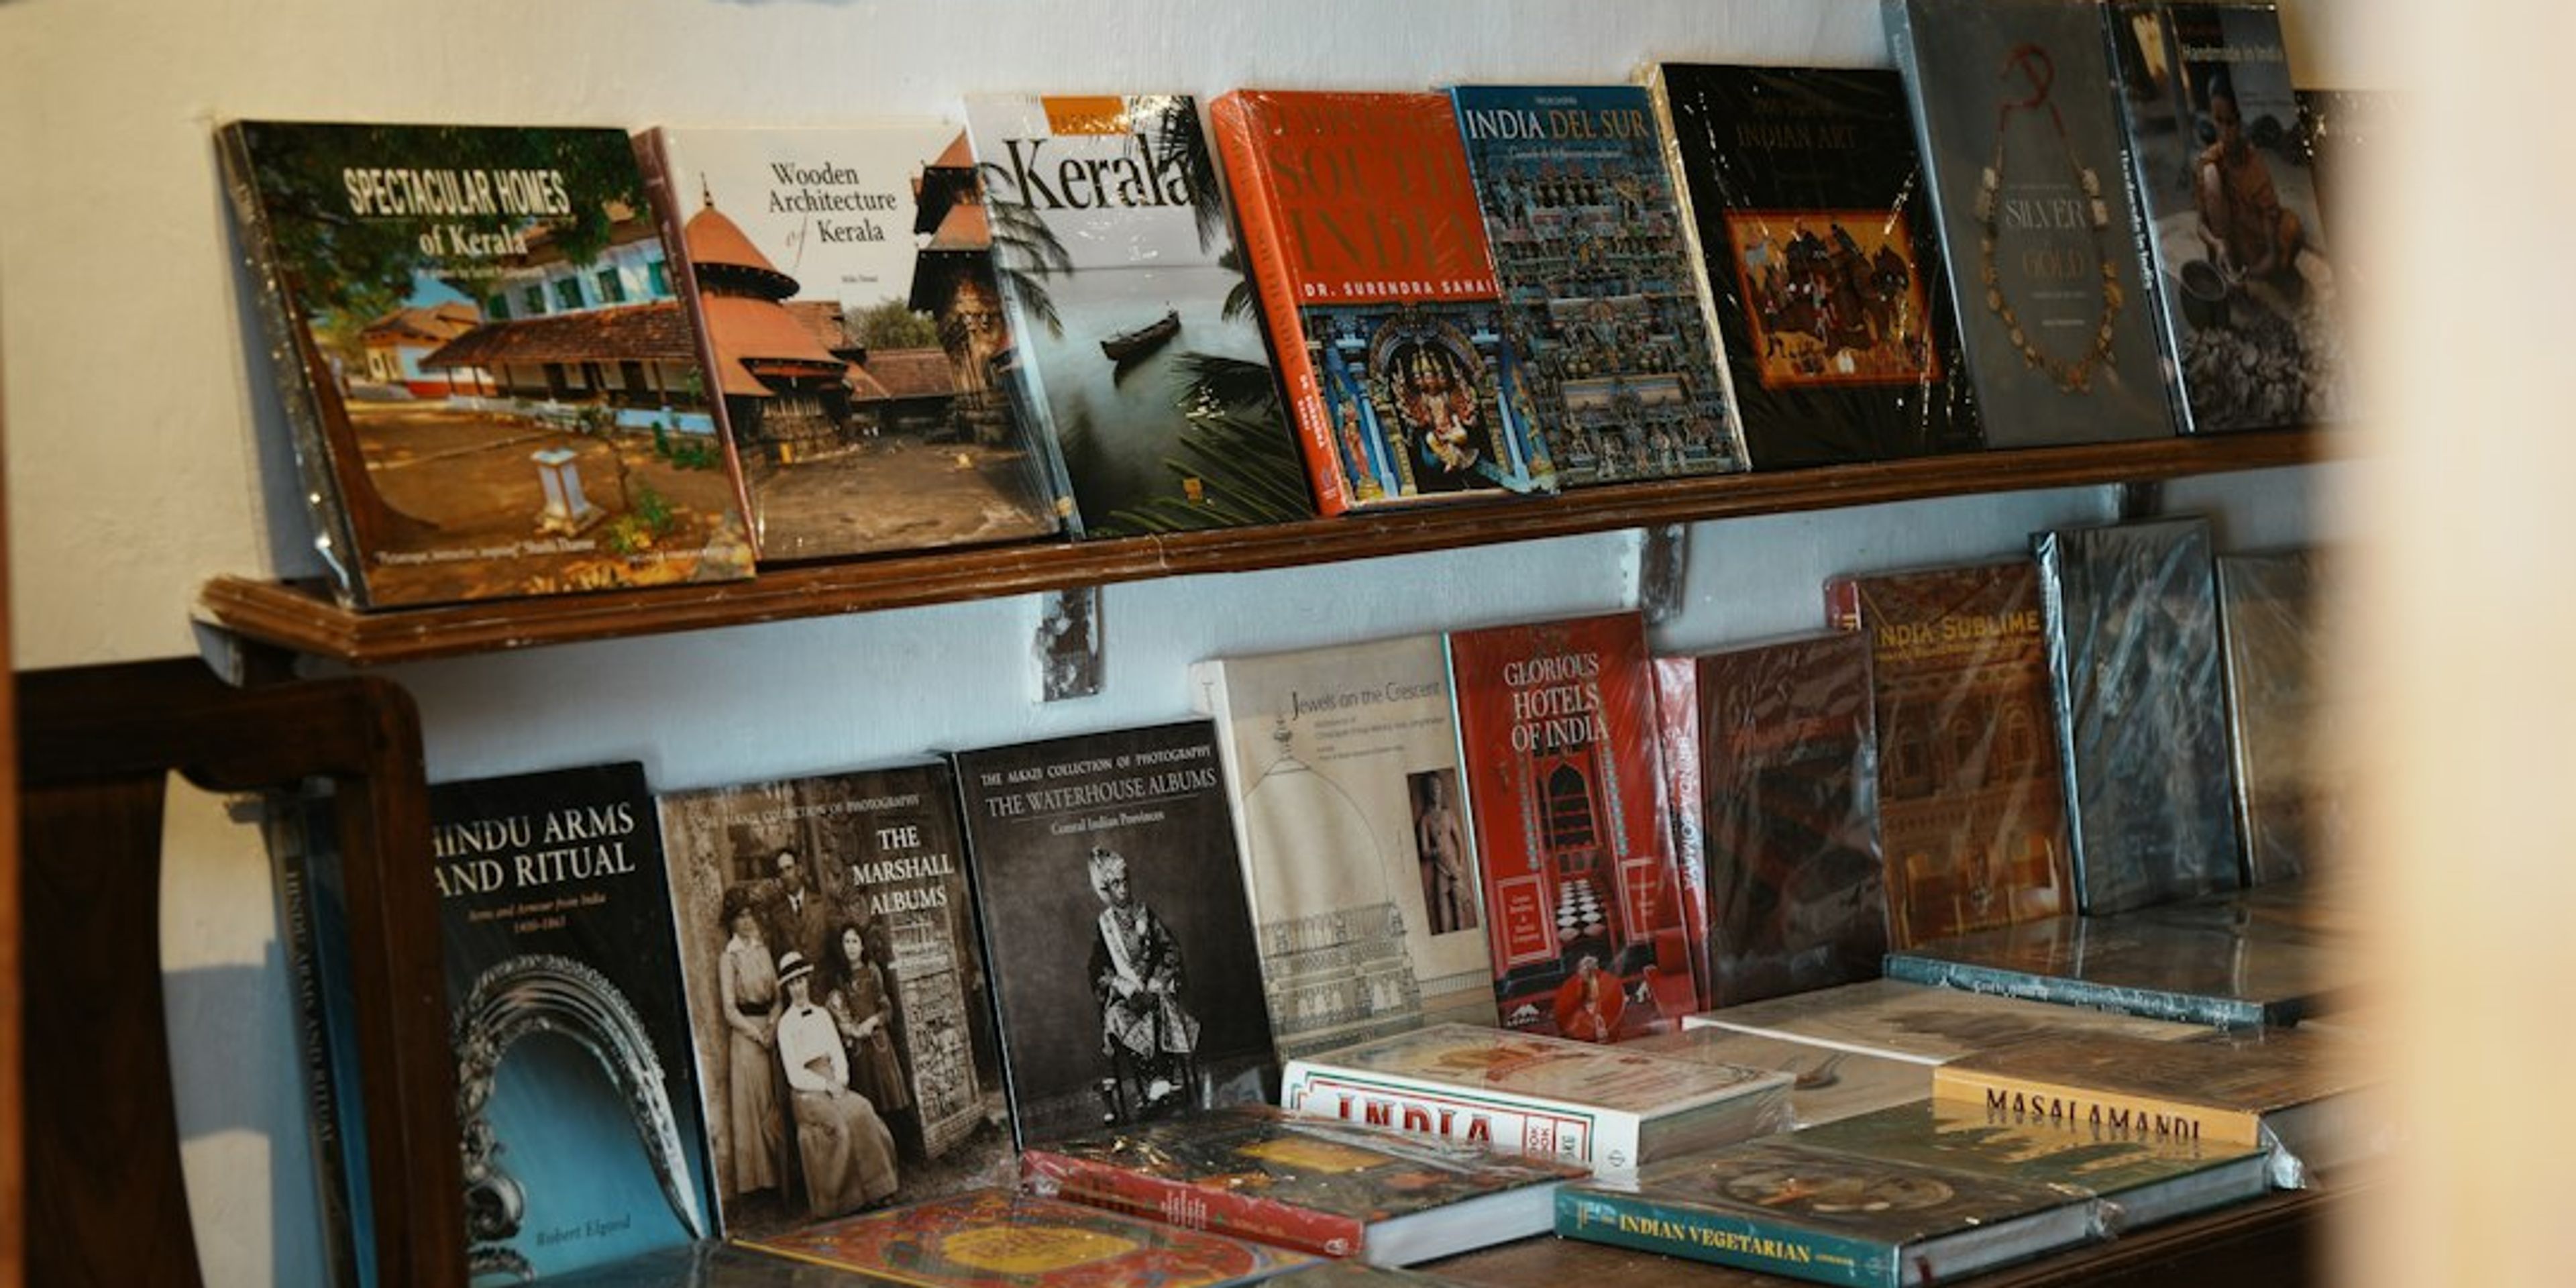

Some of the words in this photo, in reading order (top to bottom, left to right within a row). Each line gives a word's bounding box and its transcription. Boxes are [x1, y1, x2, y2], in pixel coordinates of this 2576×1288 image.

[1466, 109, 1545, 140] INDIA
[1548, 109, 1597, 140] DEL
[1600, 109, 1650, 140] SUR
[771, 160, 859, 184] Wooden
[1003, 133, 1196, 209] Kerala
[343, 167, 497, 215] SPECTACULAR
[494, 169, 570, 215] HOMES
[770, 188, 898, 213] Architecture
[817, 217, 885, 243] Kerala
[2005, 199, 2086, 229] SILVER
[419, 224, 445, 256] of
[448, 224, 528, 256] Kerala
[1304, 282, 1336, 297] DR.
[1344, 280, 1434, 296] SURENDRA
[1876, 623, 1933, 647] NDIA
[1943, 609, 2040, 639] SUBLIME
[1504, 653, 1599, 686] GLORIOUS
[1292, 691, 1336, 720] Jewels
[1340, 693, 1358, 706] on
[1361, 690, 1383, 704] the
[1385, 682, 1440, 702] Crescent
[1513, 682, 1600, 720] HOTELS
[1511, 722, 1540, 752] OF
[1545, 715, 1609, 748] INDIA
[980, 772, 1002, 786] THE
[1046, 757, 1112, 779] COLLECTION
[1116, 755, 1132, 769] OF
[1136, 745, 1212, 765] PHOTOGRAPHY
[985, 795, 1026, 818] THE
[1026, 777, 1146, 812] WATERHOUSE
[1148, 767, 1218, 796] ALBUMS
[543, 802, 635, 843] ARMS
[877, 826, 920, 851] THE
[1051, 818, 1086, 836] Central
[1087, 814, 1118, 831] Indian
[1120, 810, 1165, 828] Provinces
[514, 841, 635, 888] RITUAL
[853, 853, 955, 886] MARSHALL
[870, 885, 948, 916] ALBUMS
[1619, 1213, 1685, 1240] INDIAN
[1688, 1226, 1811, 1264] VEGETARIAN
